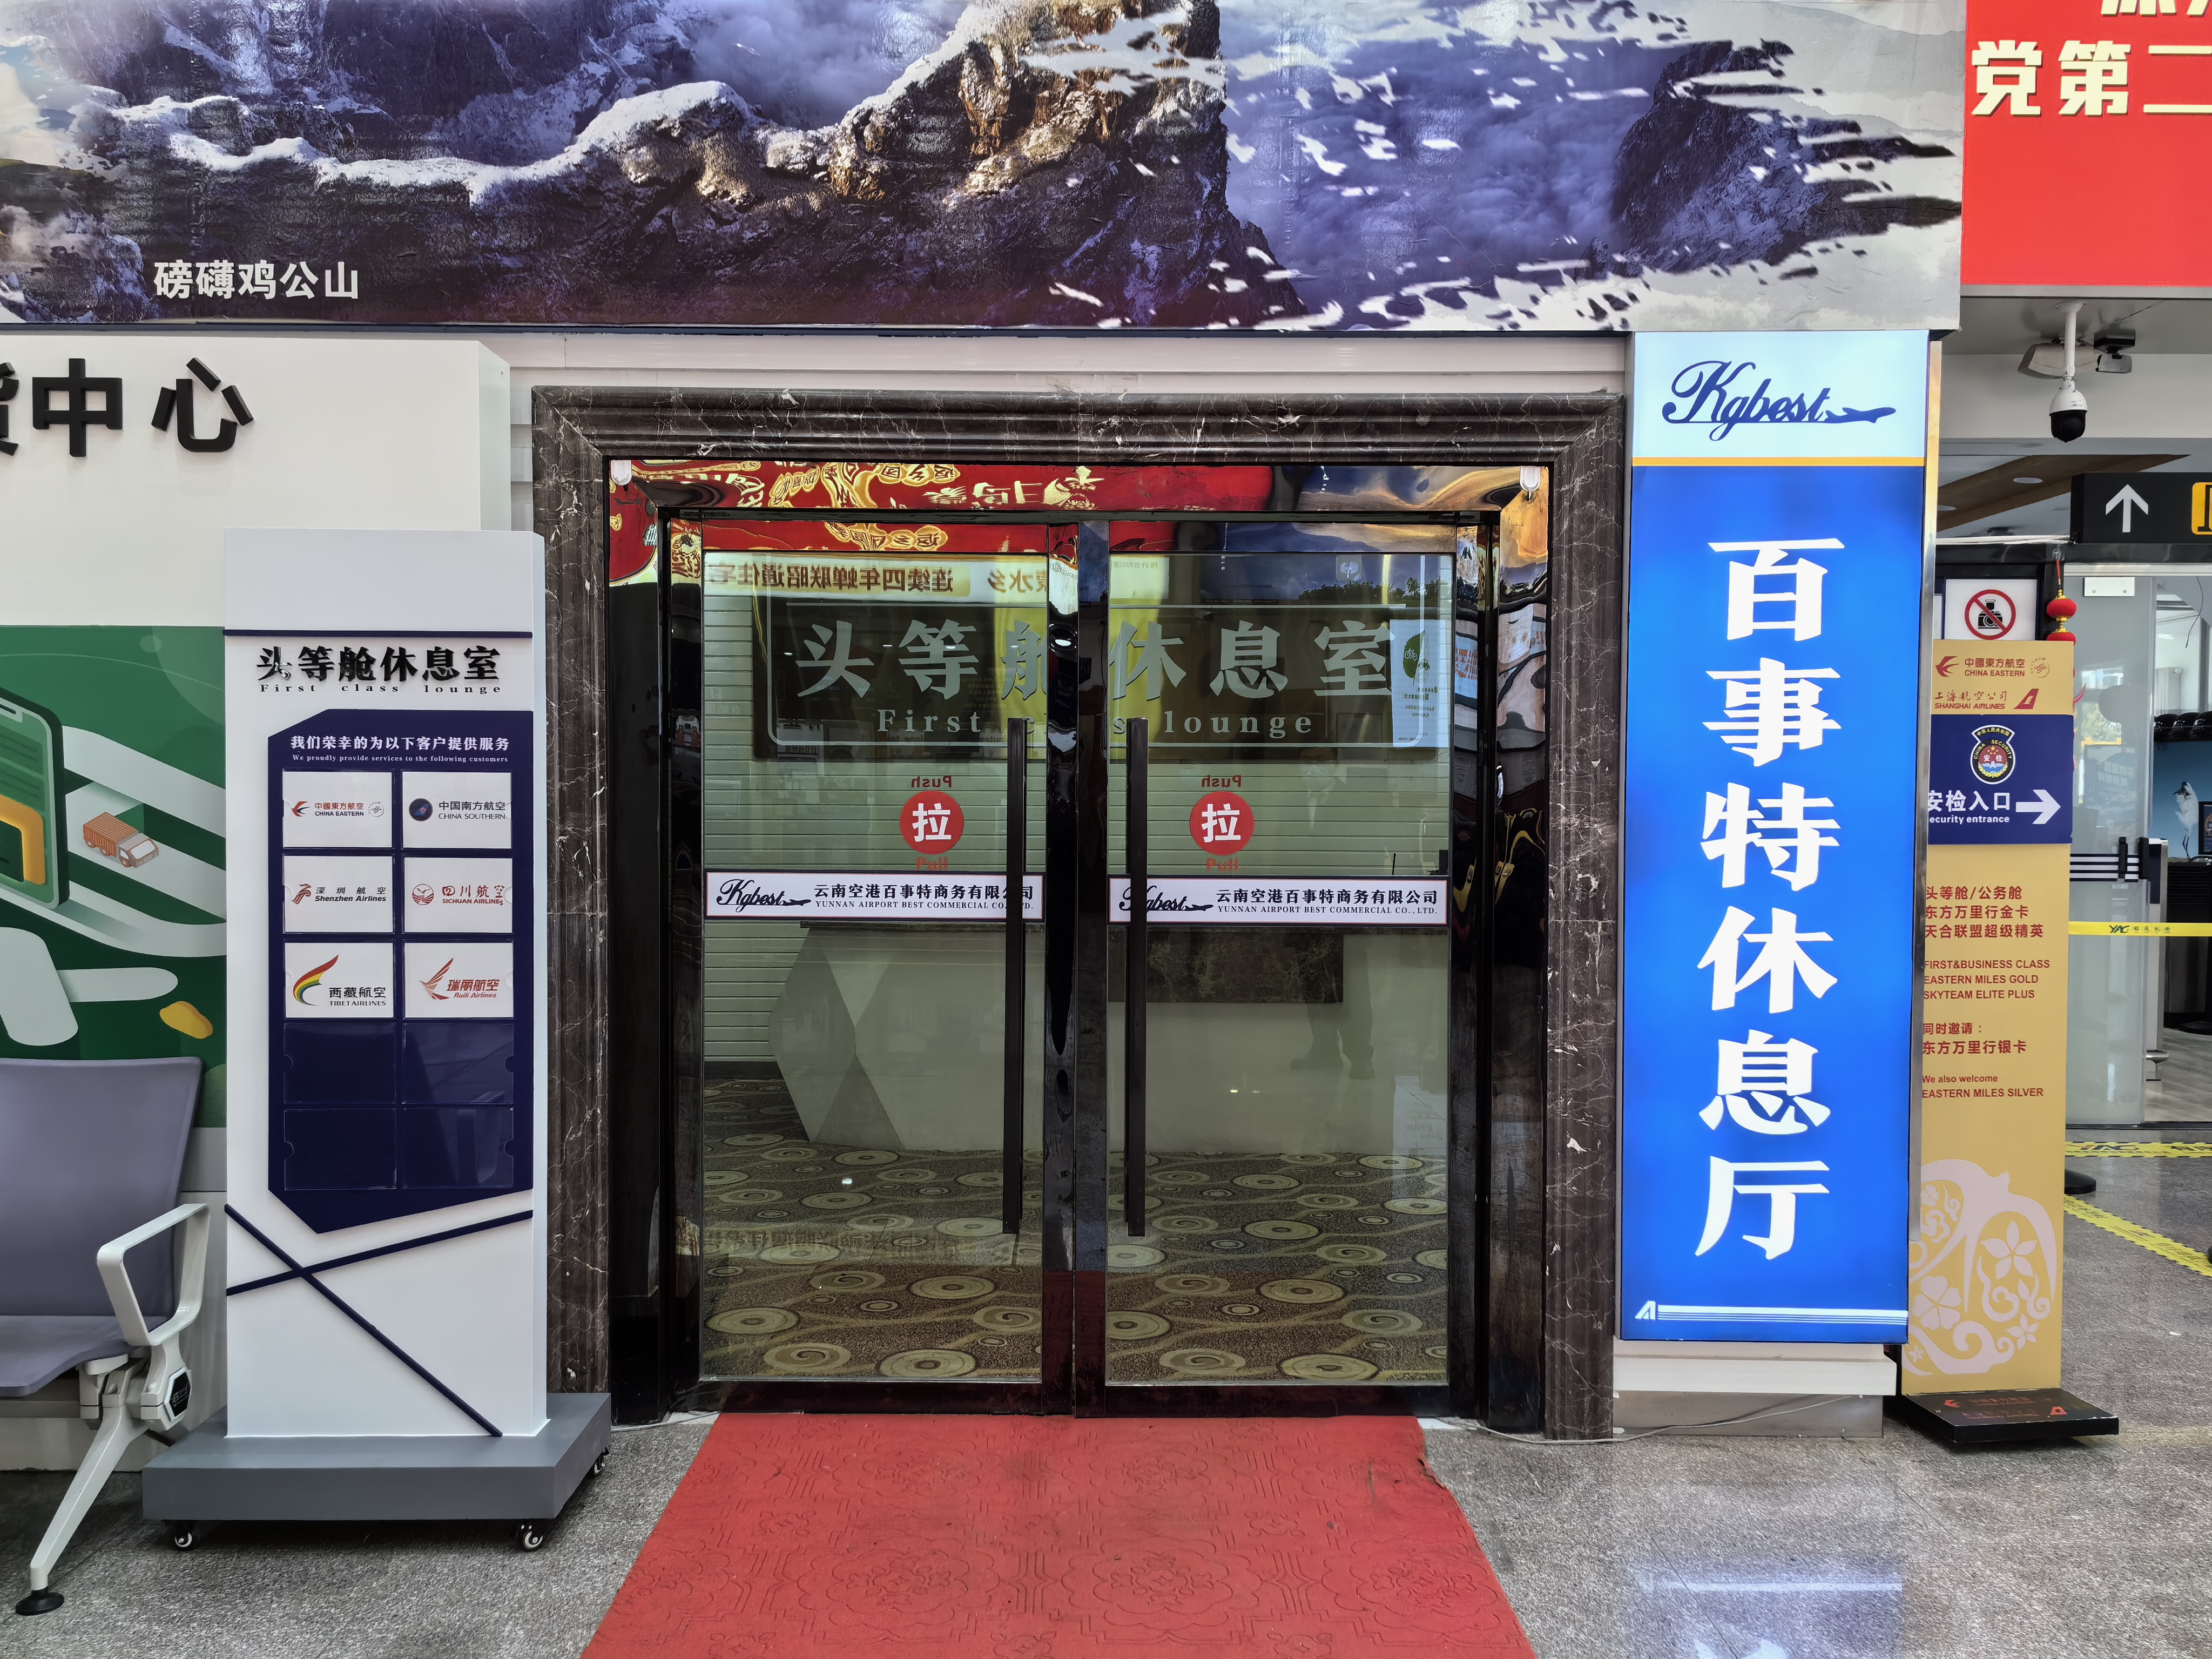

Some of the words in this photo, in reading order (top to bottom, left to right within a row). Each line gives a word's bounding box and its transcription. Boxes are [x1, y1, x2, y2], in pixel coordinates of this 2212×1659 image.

[153, 259, 359, 300] 磅礴鸡公山
[0, 357, 254, 457] 中心
[1662, 360, 1832, 441] Kgbest
[256, 645, 501, 682] 头等舱休息室
[1964, 658, 2025, 668] 中國東方航空
[260, 684, 316, 692] First
[341, 684, 399, 692] class
[424, 684, 501, 694] lounge
[1934, 689, 2007, 702] 上海航空公司
[877, 709, 982, 733] First
[1164, 710, 1313, 738] lounge
[291, 735, 510, 751] 我们荣幸的为以下客户提供服务
[1973, 743, 1986, 760] CHINA
[1991, 739, 2013, 759] SECURITY
[314, 802, 364, 810] 中國東方航空
[439, 801, 506, 811] 中国南方航空
[1928, 790, 2010, 812] 安检入口
[912, 802, 952, 842] 拉
[1201, 803, 1241, 843] 拉
[1929, 815, 1964, 825] ecurity
[1966, 815, 2009, 823] entrance
[916, 856, 948, 871] Pull
[1205, 858, 1239, 872] Pull
[316, 887, 386, 895] 深圳航空
[442, 885, 505, 898] 四川航空
[814, 883, 1033, 900] 云南空港百事特商务有限司
[1216, 888, 1438, 905] 云南空港百事特商务有限公司
[1926, 886, 2022, 900] 头等舱/公务舱
[1695, 537, 1845, 1260] 百事特休息厅
[1925, 905, 2029, 919] 东方万里行金卡
[1925, 923, 2044, 939] 天合联盟超级精英
[1924, 960, 2013, 969] FIRST&BUSINESS
[2015, 959, 2051, 968] CLASS
[446, 979, 500, 992] 瑞丽航空
[1924, 975, 1972, 984] EASTERN
[1975, 975, 2006, 984] MILES
[2009, 974, 2039, 983] GOLD
[328, 987, 387, 999] 西藏航空
[1924, 990, 1973, 999] SKYTEAM
[1975, 990, 2005, 999] ELITE
[2008, 989, 2035, 999] PLUS
[1923, 1040, 2027, 1055] 东方万里行银卡
[1938, 1075, 1957, 1083] also
[1959, 1074, 1998, 1082] welcome
[1922, 1089, 1970, 1098] EASTERN
[1973, 1088, 2005, 1097] MILES
[2007, 1088, 2044, 1097] SILVER
